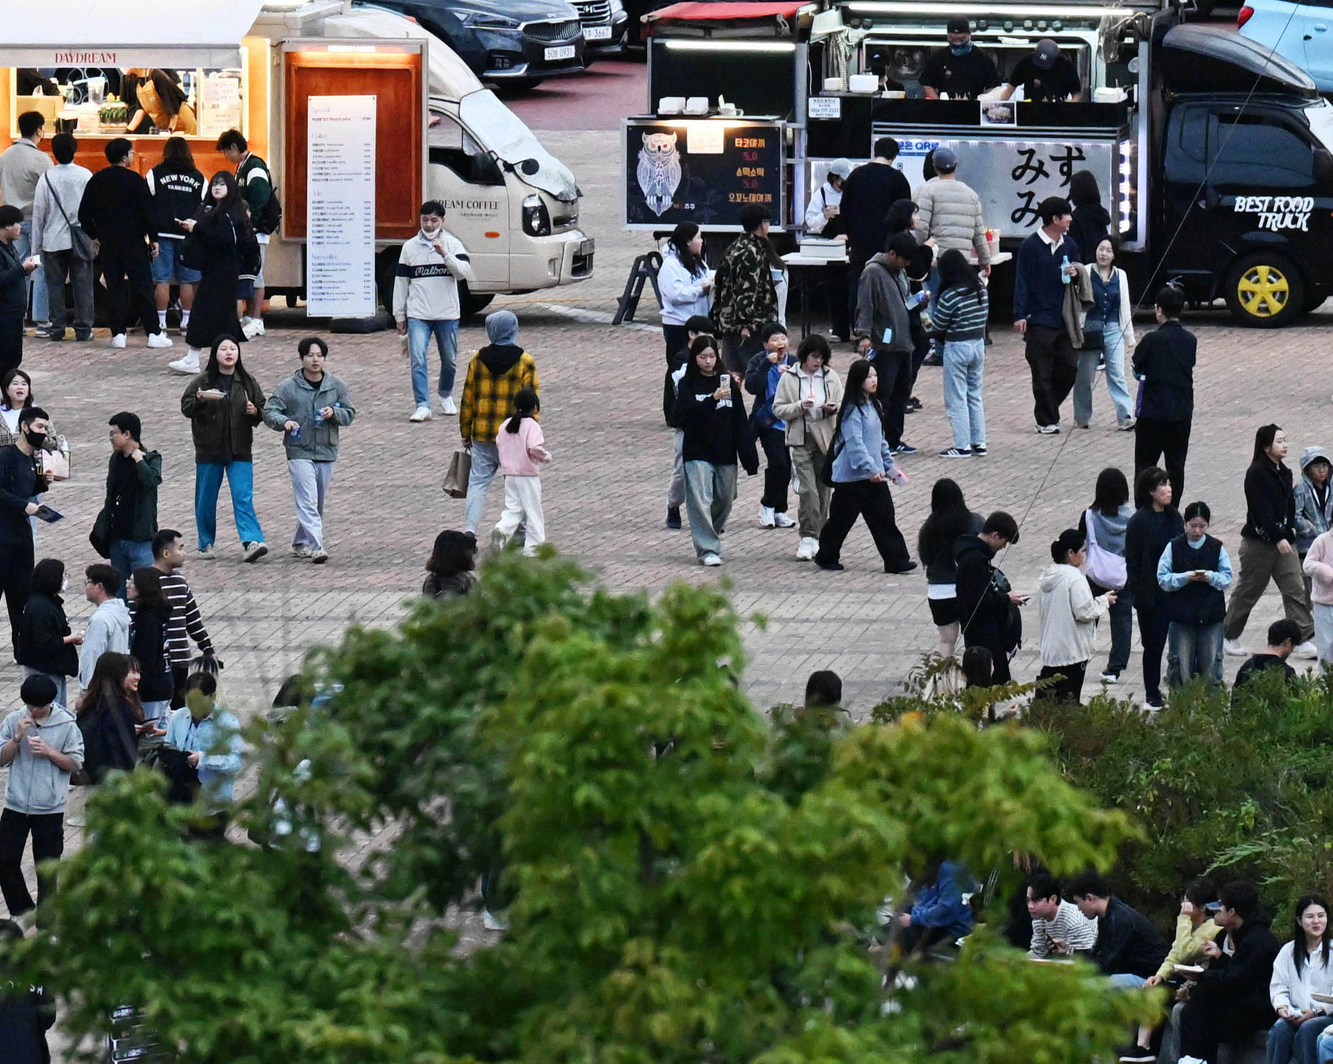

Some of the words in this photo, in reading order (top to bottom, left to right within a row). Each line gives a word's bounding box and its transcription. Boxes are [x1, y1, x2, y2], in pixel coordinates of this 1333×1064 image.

[54, 52, 117, 64] DAYDREAM
[159, 175, 179, 185] NEW
[179, 174, 201, 188] YORK
[466, 200, 501, 210] COFFEE
[1234, 196, 1273, 212] BEST
[1273, 196, 1314, 212] FOOD
[1257, 212, 1312, 232] TRUCK
